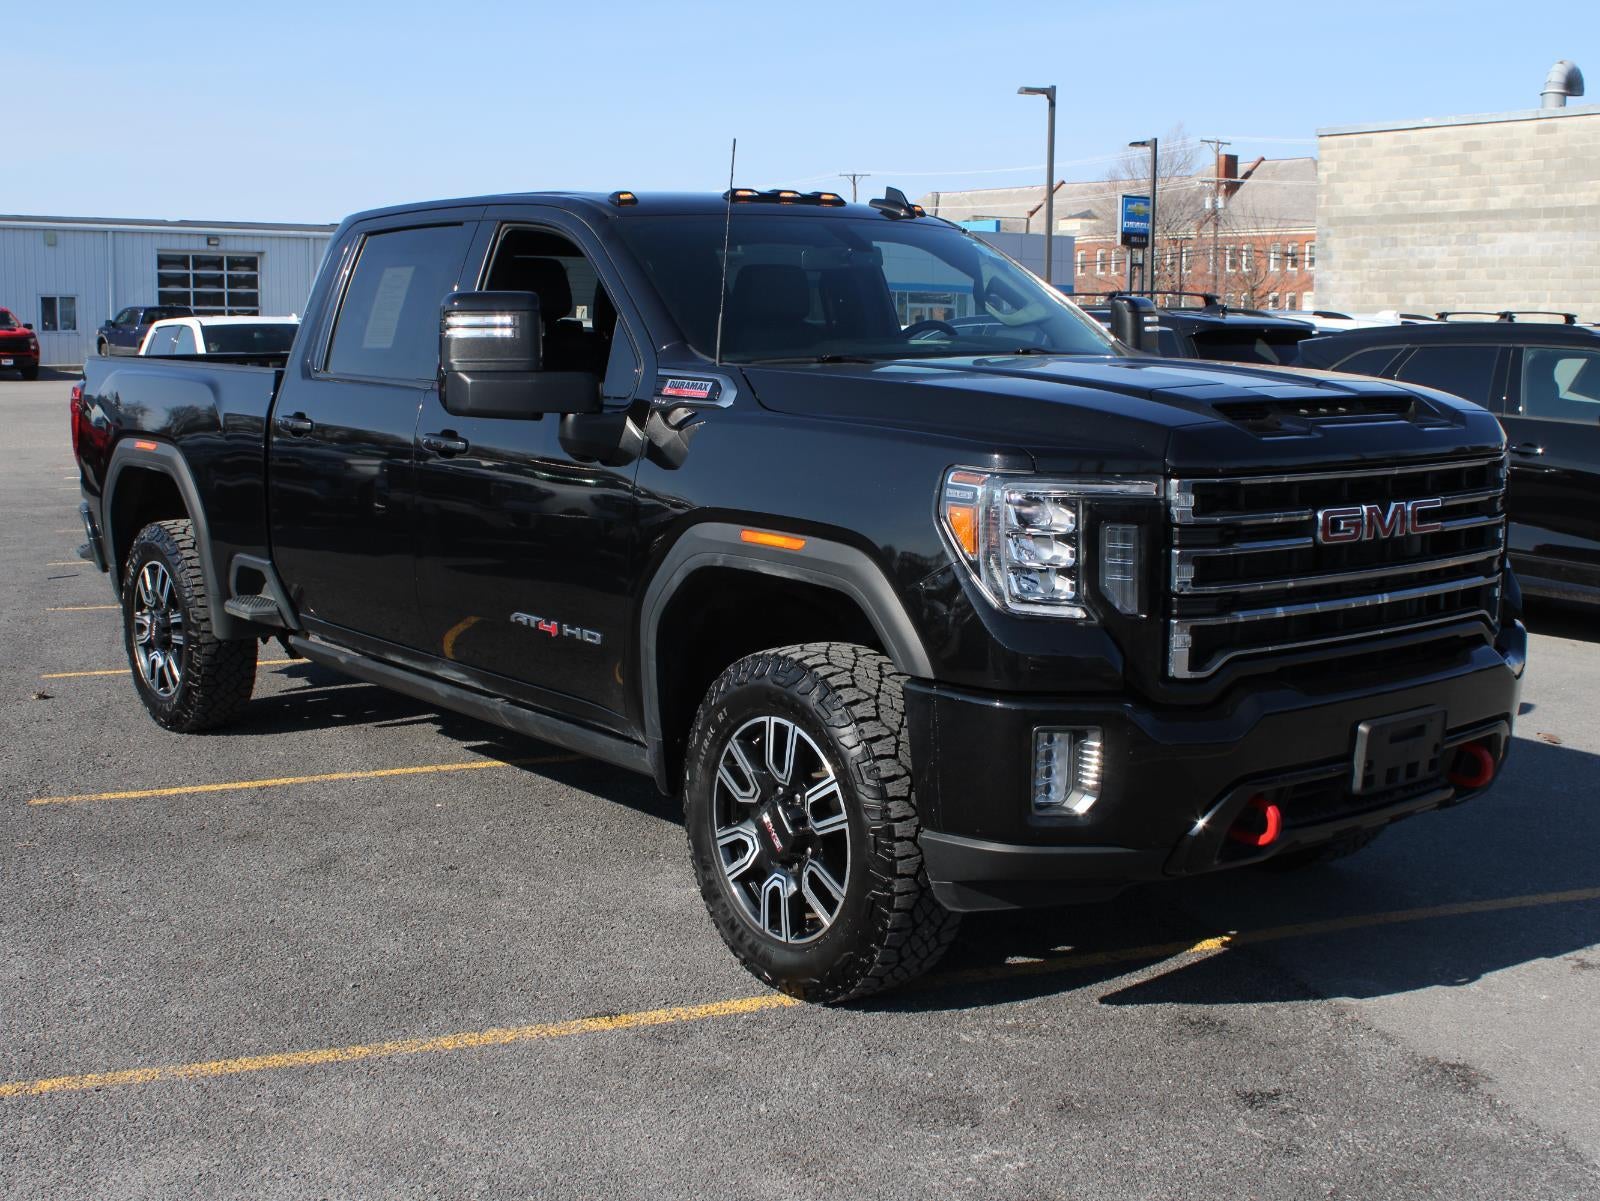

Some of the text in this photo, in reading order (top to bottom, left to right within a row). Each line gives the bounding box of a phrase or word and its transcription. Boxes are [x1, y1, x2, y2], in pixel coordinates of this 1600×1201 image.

[1124, 221, 1150, 229] CHEVROL
[668, 380, 710, 392] DURAMAX
[1316, 498, 1442, 545] GMC
[510, 612, 602, 645] AT4 HD
